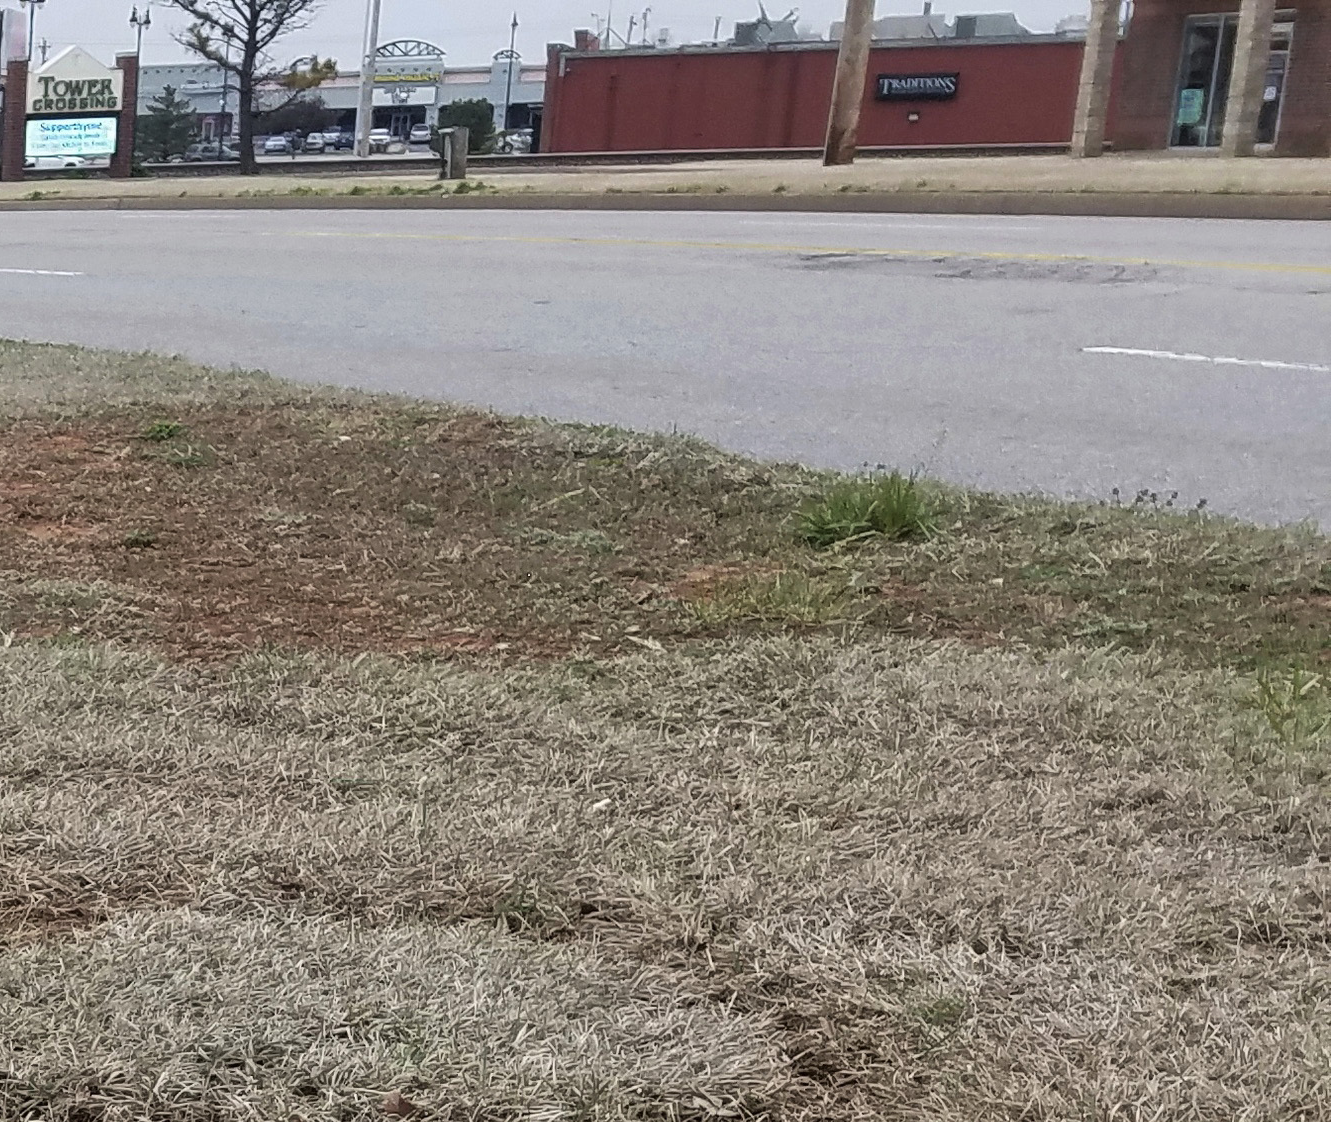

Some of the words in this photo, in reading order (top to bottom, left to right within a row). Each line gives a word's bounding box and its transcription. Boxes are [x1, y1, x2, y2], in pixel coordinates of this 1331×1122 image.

[38, 76, 114, 98] TOWER
[879, 77, 956, 94] TRADITIONS
[32, 97, 118, 111] CROSSING
